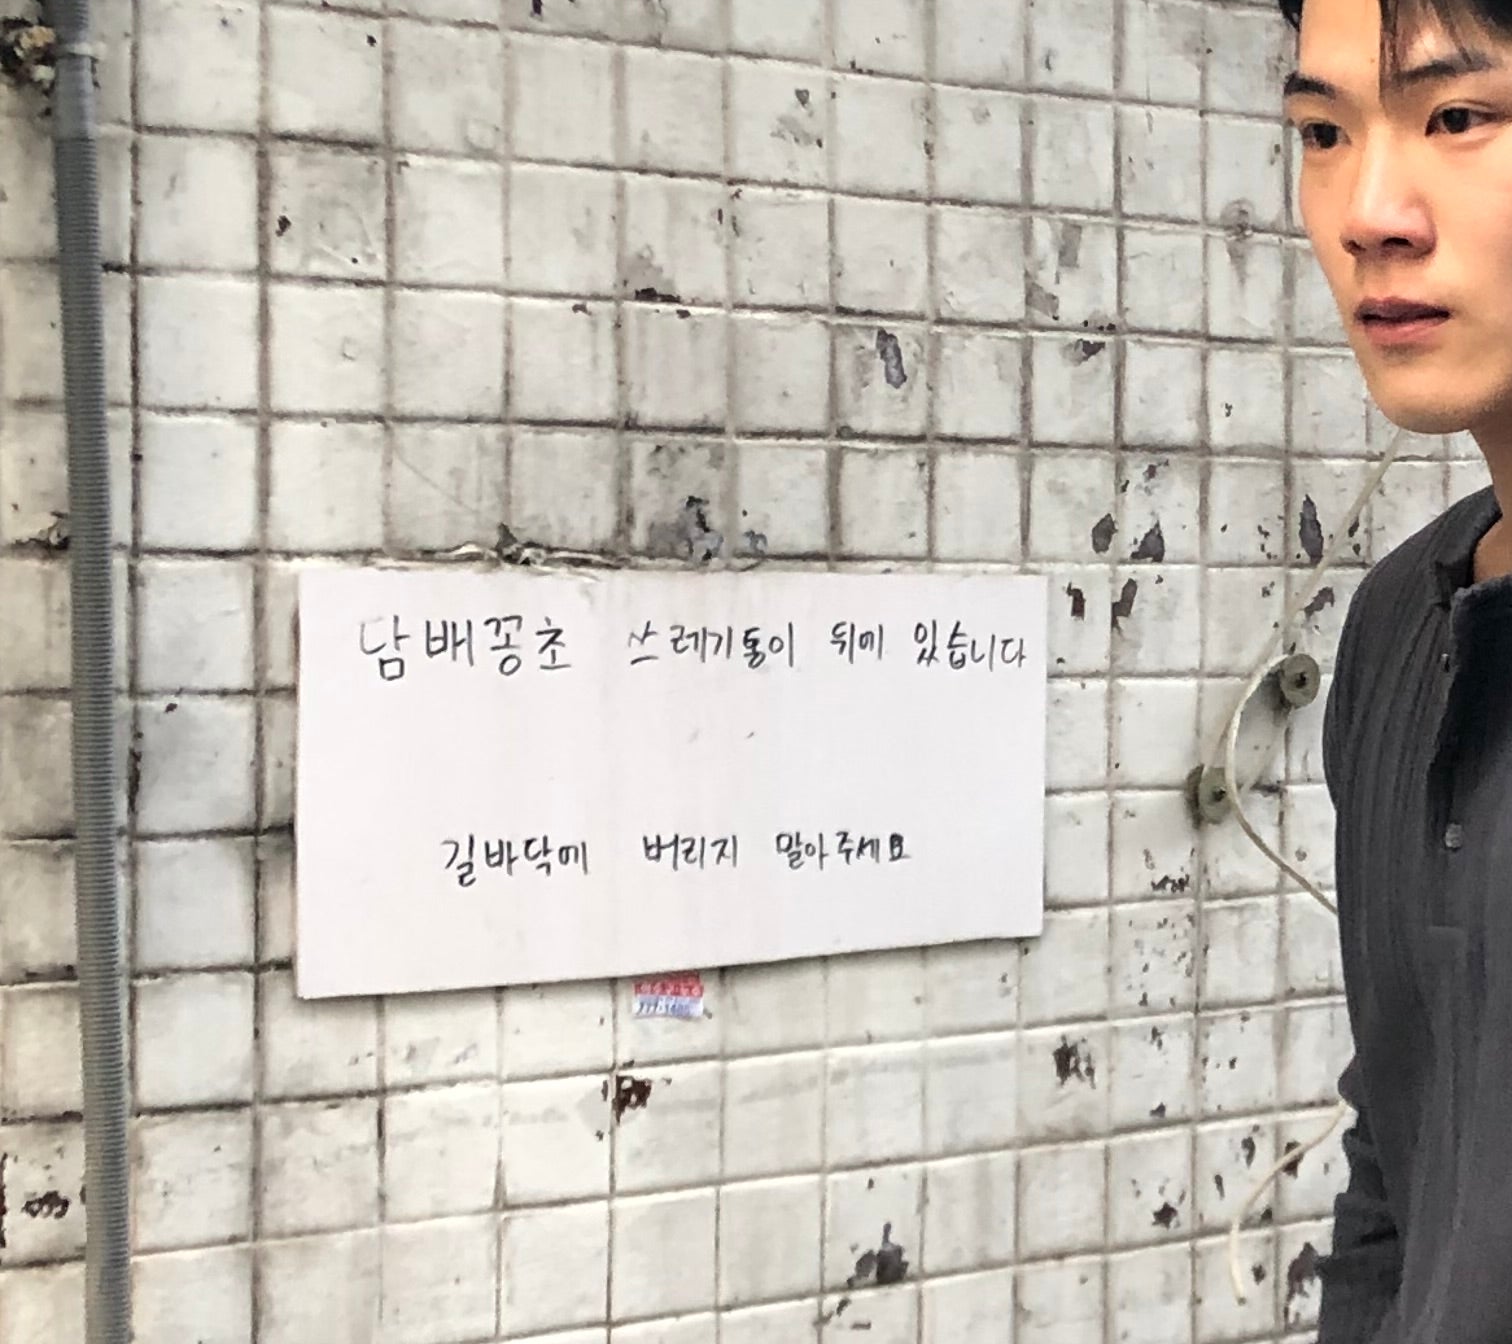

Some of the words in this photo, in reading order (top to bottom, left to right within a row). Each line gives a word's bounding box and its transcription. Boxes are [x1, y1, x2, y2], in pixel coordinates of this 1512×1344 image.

[358, 614, 572, 682] 담배꽁초
[626, 619, 795, 670] 쓰레기통이
[829, 620, 884, 665] 뒤에
[912, 618, 1028, 673] 있습니다
[440, 832, 589, 888] 길바닥에
[642, 832, 739, 872] 버리지
[774, 830, 912, 872] 말아주세요
